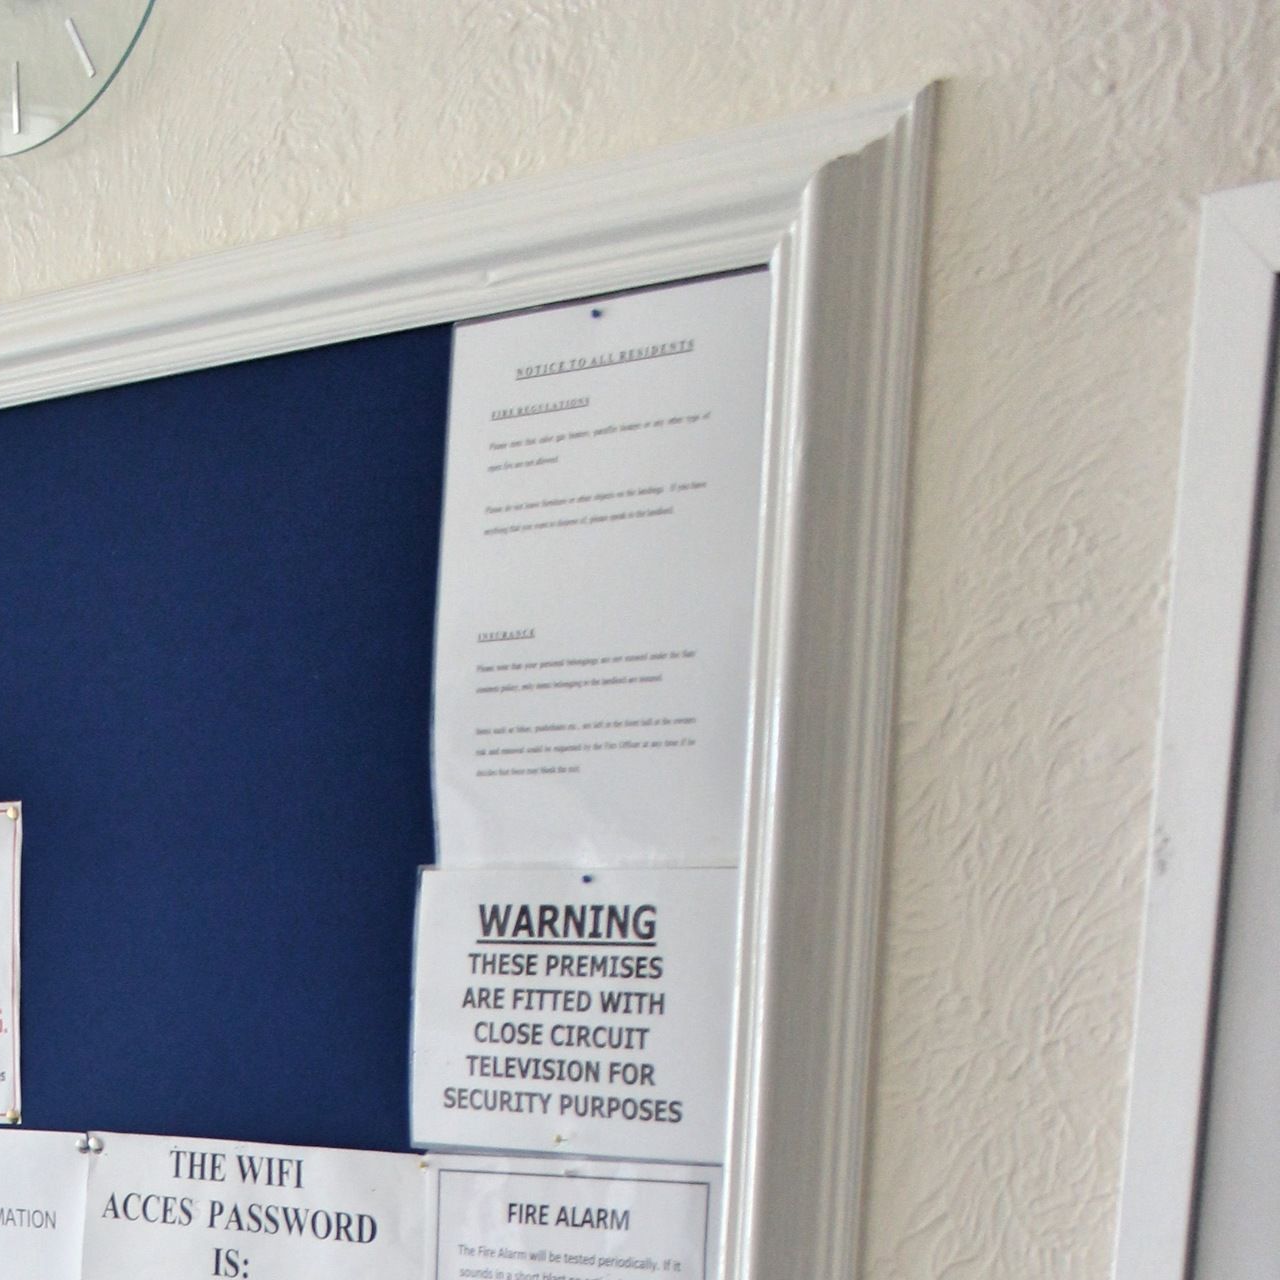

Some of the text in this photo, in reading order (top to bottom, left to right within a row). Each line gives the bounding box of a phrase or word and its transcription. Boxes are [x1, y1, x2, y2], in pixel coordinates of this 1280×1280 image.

[516, 339, 695, 377] NOTICE TO ALL RESIDENTS
[478, 903, 657, 940] WARNING
[468, 953, 664, 980] THESE PREMISES
[462, 987, 666, 1016] ARE FITTED WITH
[474, 1022, 650, 1050] CLOSE CIRCUIT
[466, 1055, 656, 1086] TELEVISION FOR
[443, 1088, 683, 1123] SECURITY PURPOSES
[170, 1150, 304, 1188] THE WIFI
[102, 1192, 377, 1244] ACCES PASSWORD
[507, 1203, 630, 1231] FIRE ALARM
[211, 1248, 249, 1279] IS:
[458, 1245, 681, 1274] The Fire Alarm will be tested periodically. If it
[459, 1267, 492, 1280] sounds
[495, 1270, 504, 1280] in
